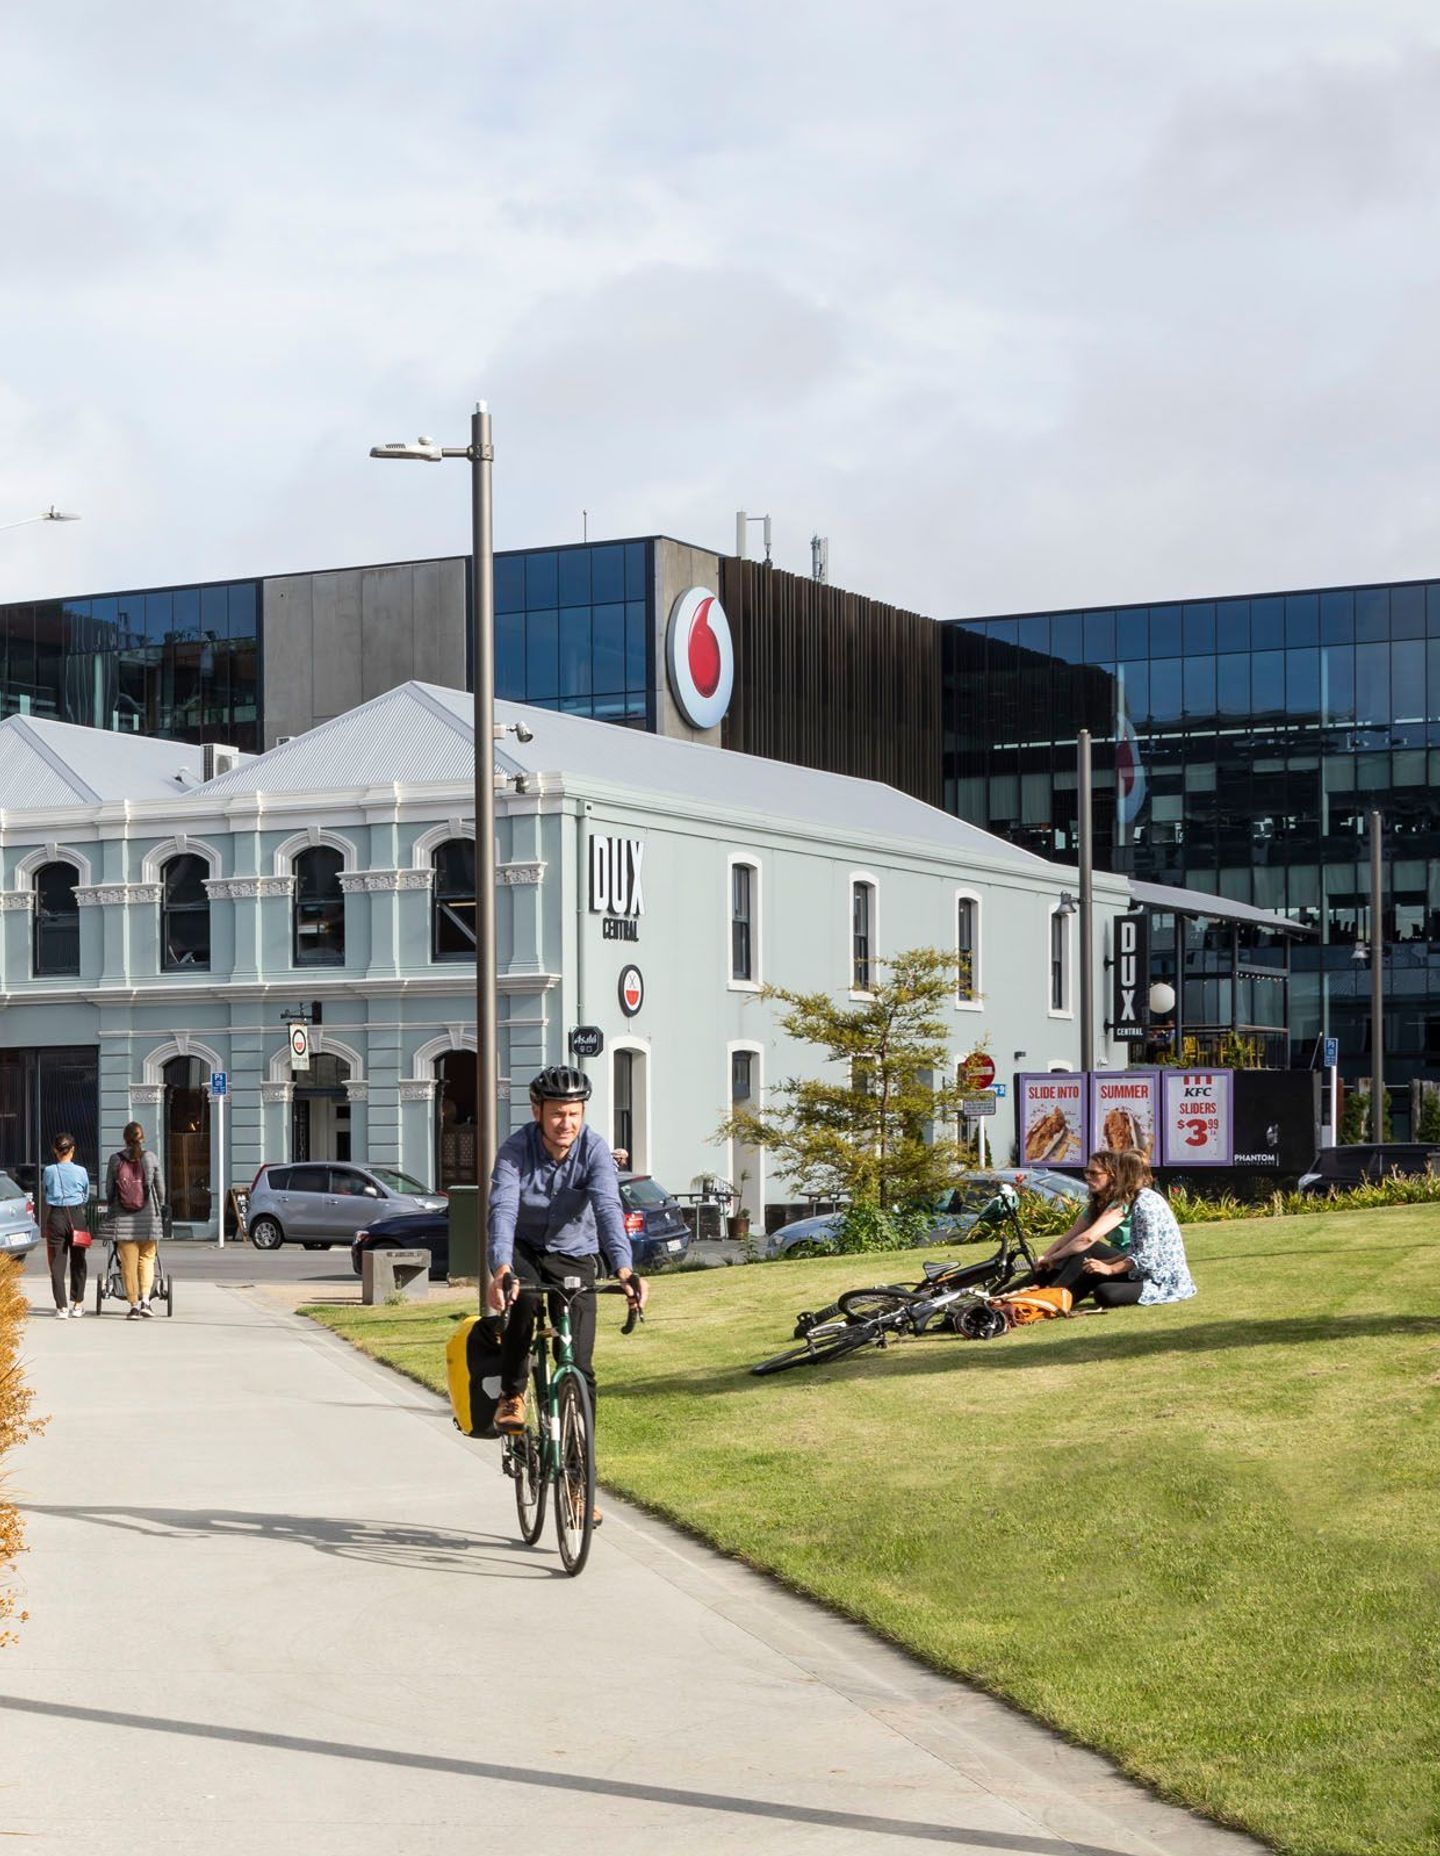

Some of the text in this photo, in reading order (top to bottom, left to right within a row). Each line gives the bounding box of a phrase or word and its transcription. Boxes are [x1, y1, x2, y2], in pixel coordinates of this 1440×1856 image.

[589, 834, 645, 916] DUX
[603, 917, 640, 942] CENTRAL
[1121, 922, 1136, 1020] DUX
[1116, 1028, 1143, 1036] CENTRAL
[1029, 1086, 1079, 1099] SLIDE INTO
[1100, 1085, 1149, 1099] SUMMER
[1184, 1087, 1212, 1097] KFC
[1179, 1103, 1217, 1114] SLIDERS
[1234, 1154, 1275, 1162] PHANTOM
